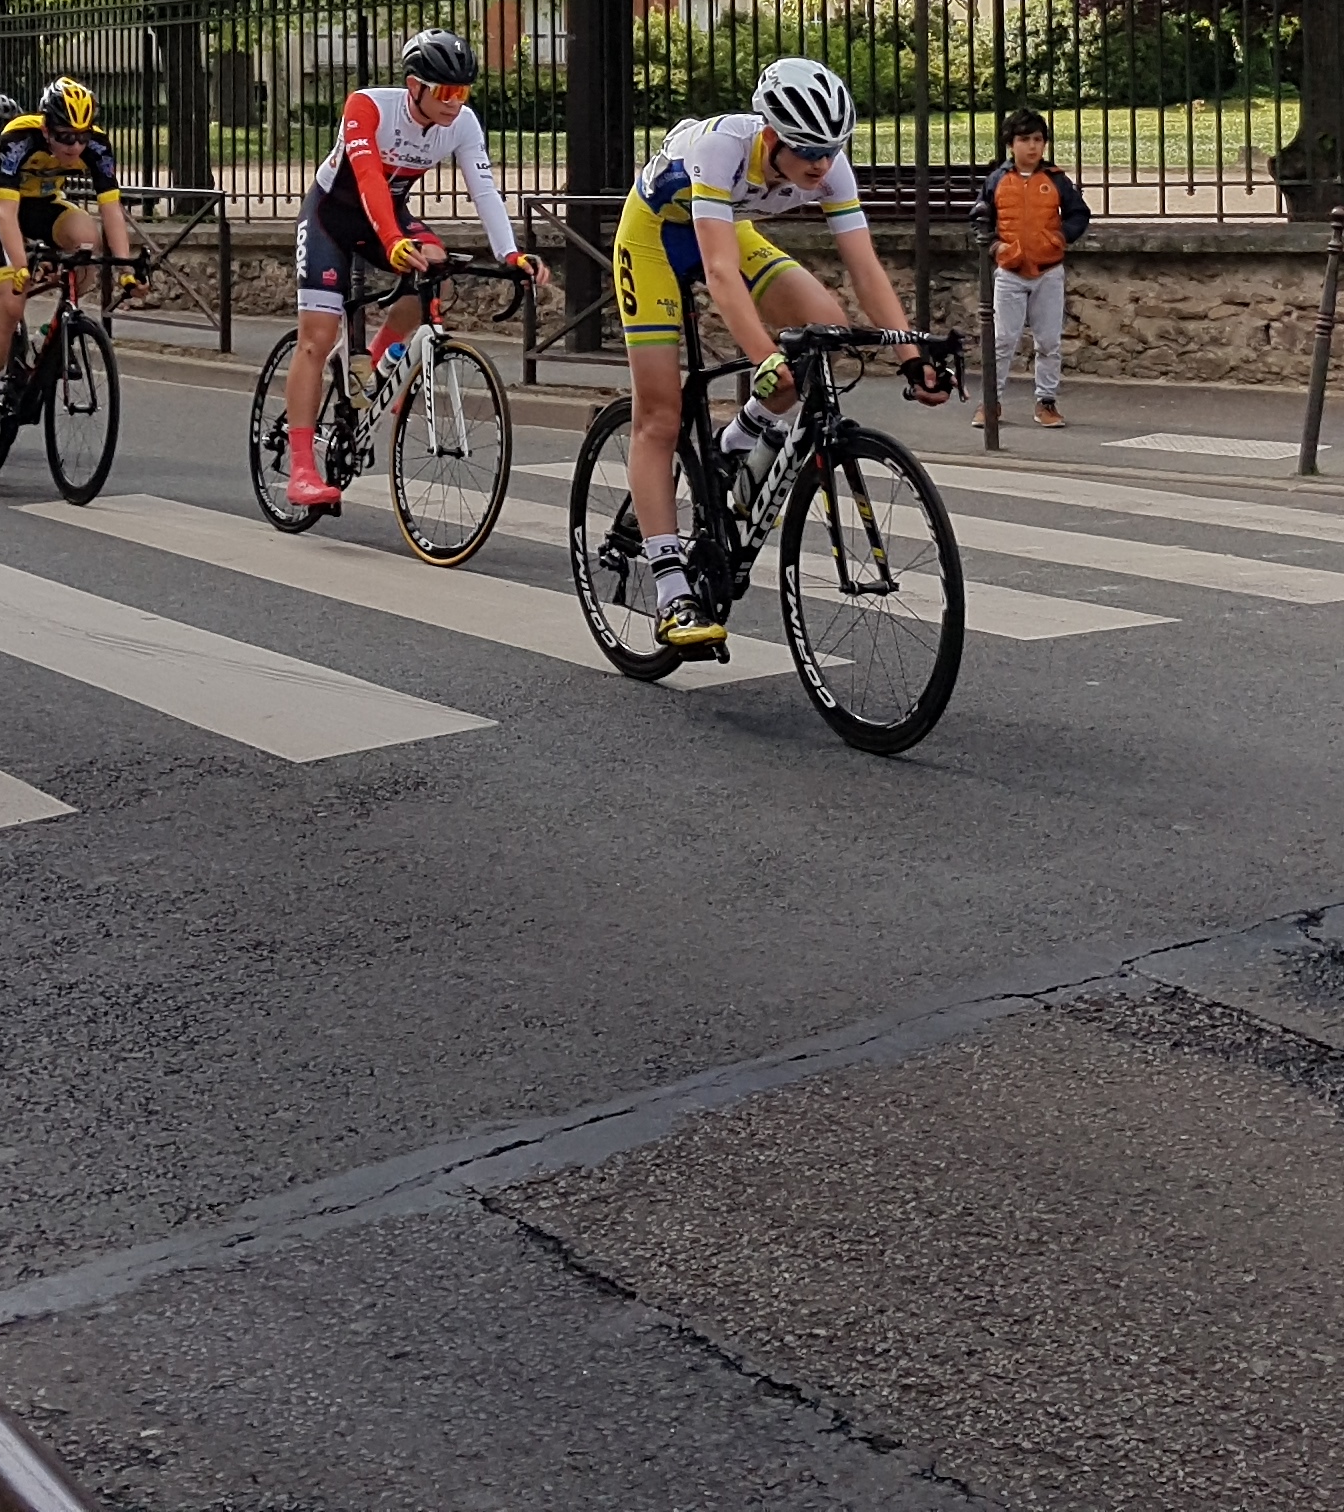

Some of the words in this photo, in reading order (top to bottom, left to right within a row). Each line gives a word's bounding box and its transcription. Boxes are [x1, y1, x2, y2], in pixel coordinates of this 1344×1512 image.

[296, 219, 308, 278] LOOK
[735, 408, 806, 548] LOOK
[573, 525, 618, 649] CORIMA
[786, 564, 837, 709] CORIMA
